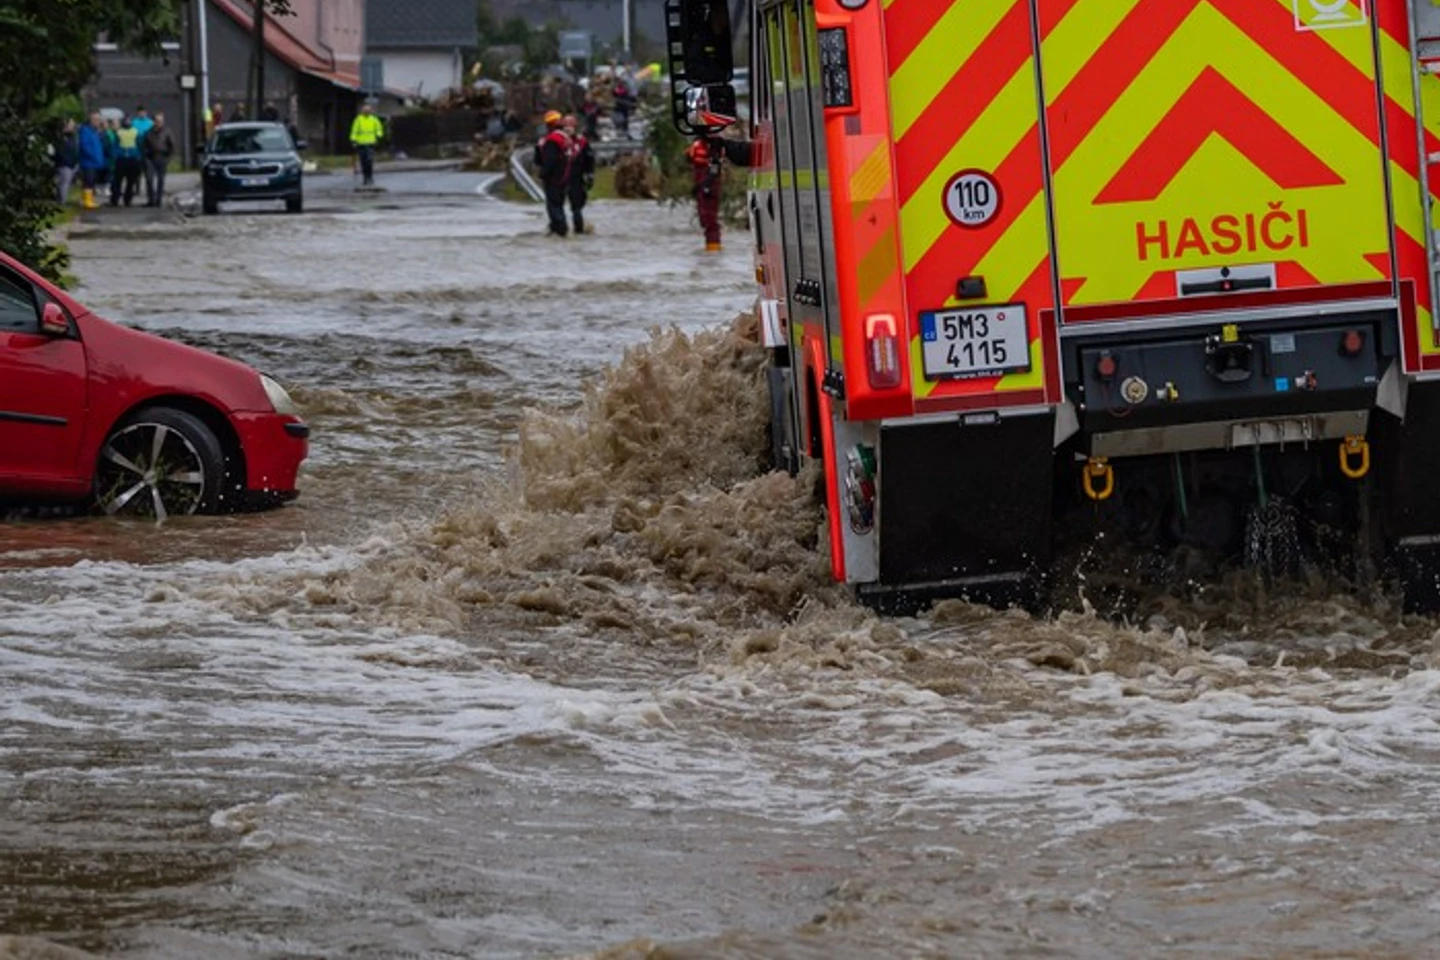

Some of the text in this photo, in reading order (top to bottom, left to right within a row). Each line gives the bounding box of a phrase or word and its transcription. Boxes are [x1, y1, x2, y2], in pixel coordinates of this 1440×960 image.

[954, 180, 989, 208] 110
[963, 208, 985, 219] km
[1136, 200, 1309, 261] HASIČI
[942, 313, 989, 340] 5M3
[946, 339, 1007, 367] 4115
